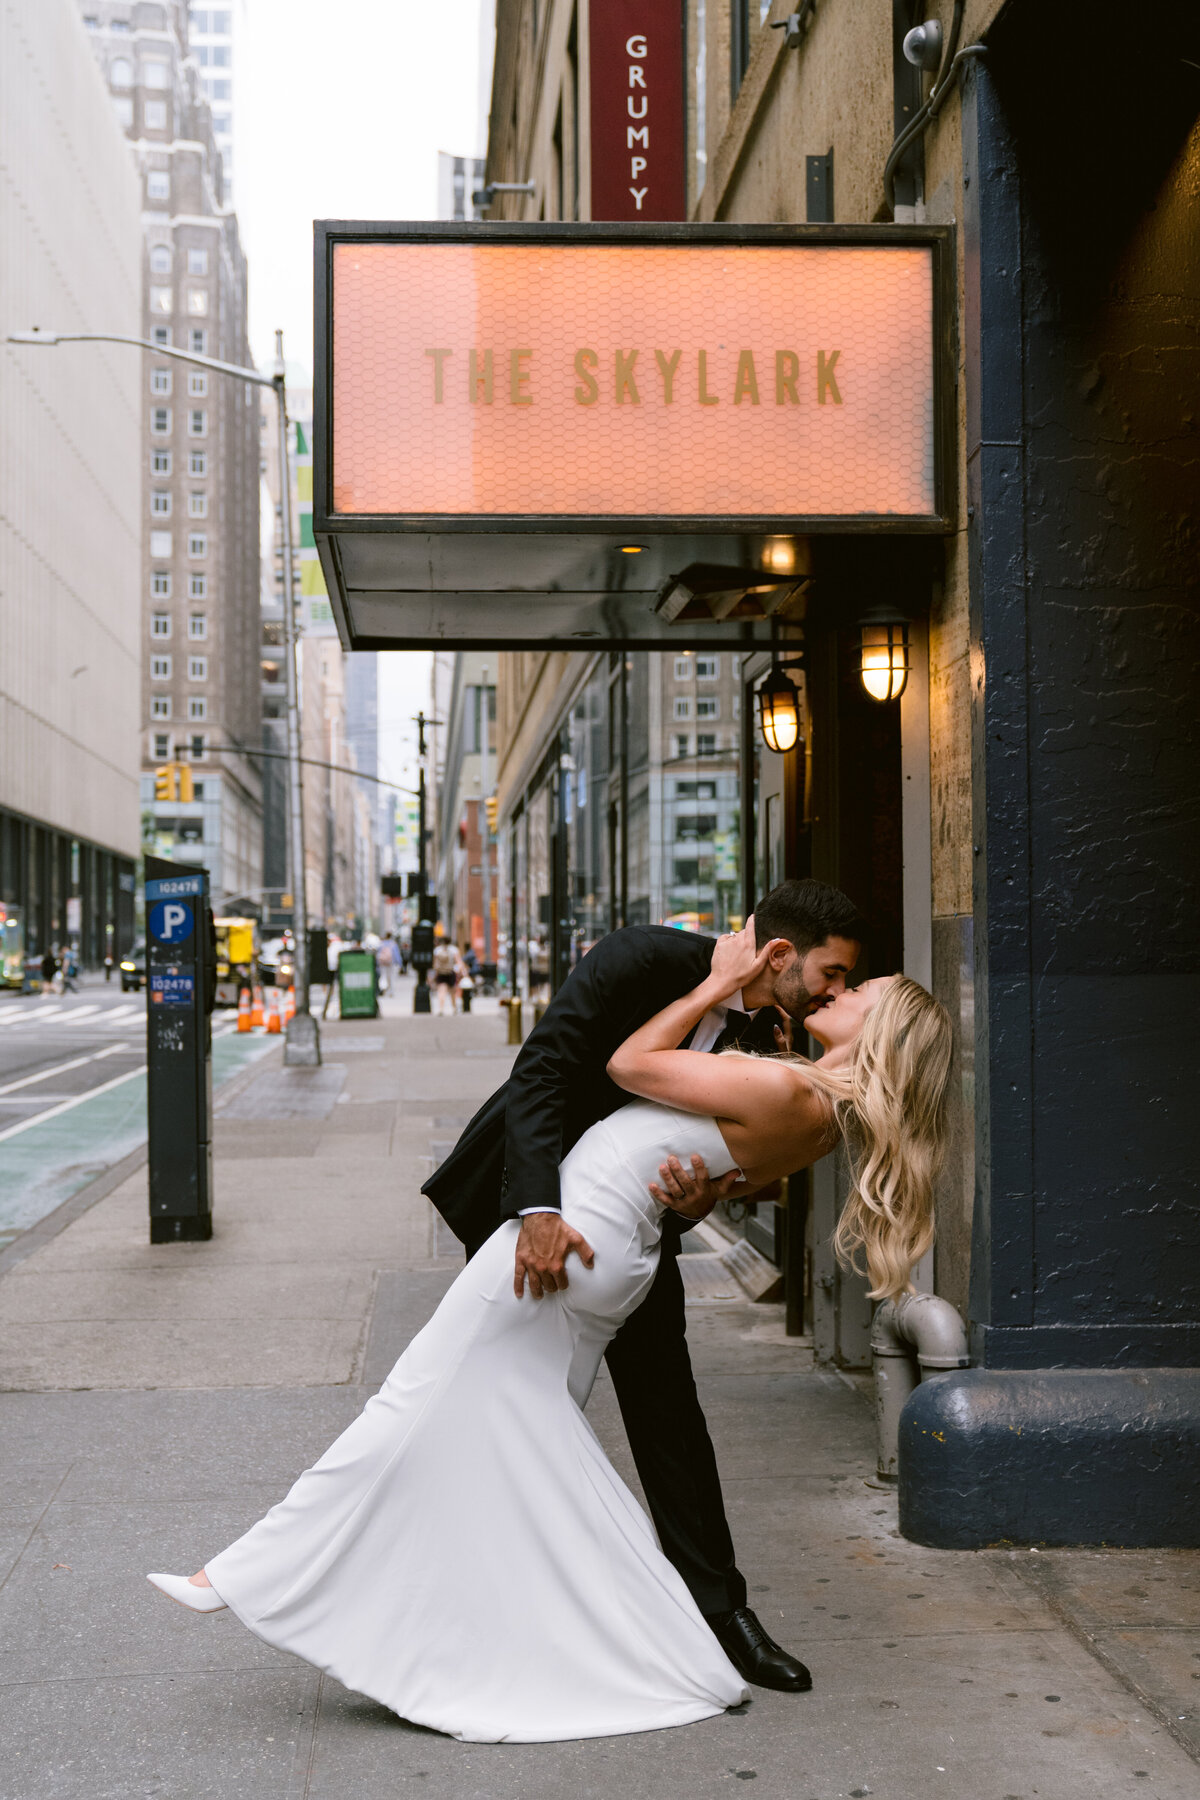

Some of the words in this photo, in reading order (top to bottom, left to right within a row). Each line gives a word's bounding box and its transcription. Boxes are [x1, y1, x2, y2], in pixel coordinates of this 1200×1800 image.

[626, 35, 649, 210] GRUMPY
[424, 348, 533, 404] THE
[574, 348, 843, 405] SKYLARK
[160, 904, 186, 939] P
[152, 979, 192, 990] 102478
